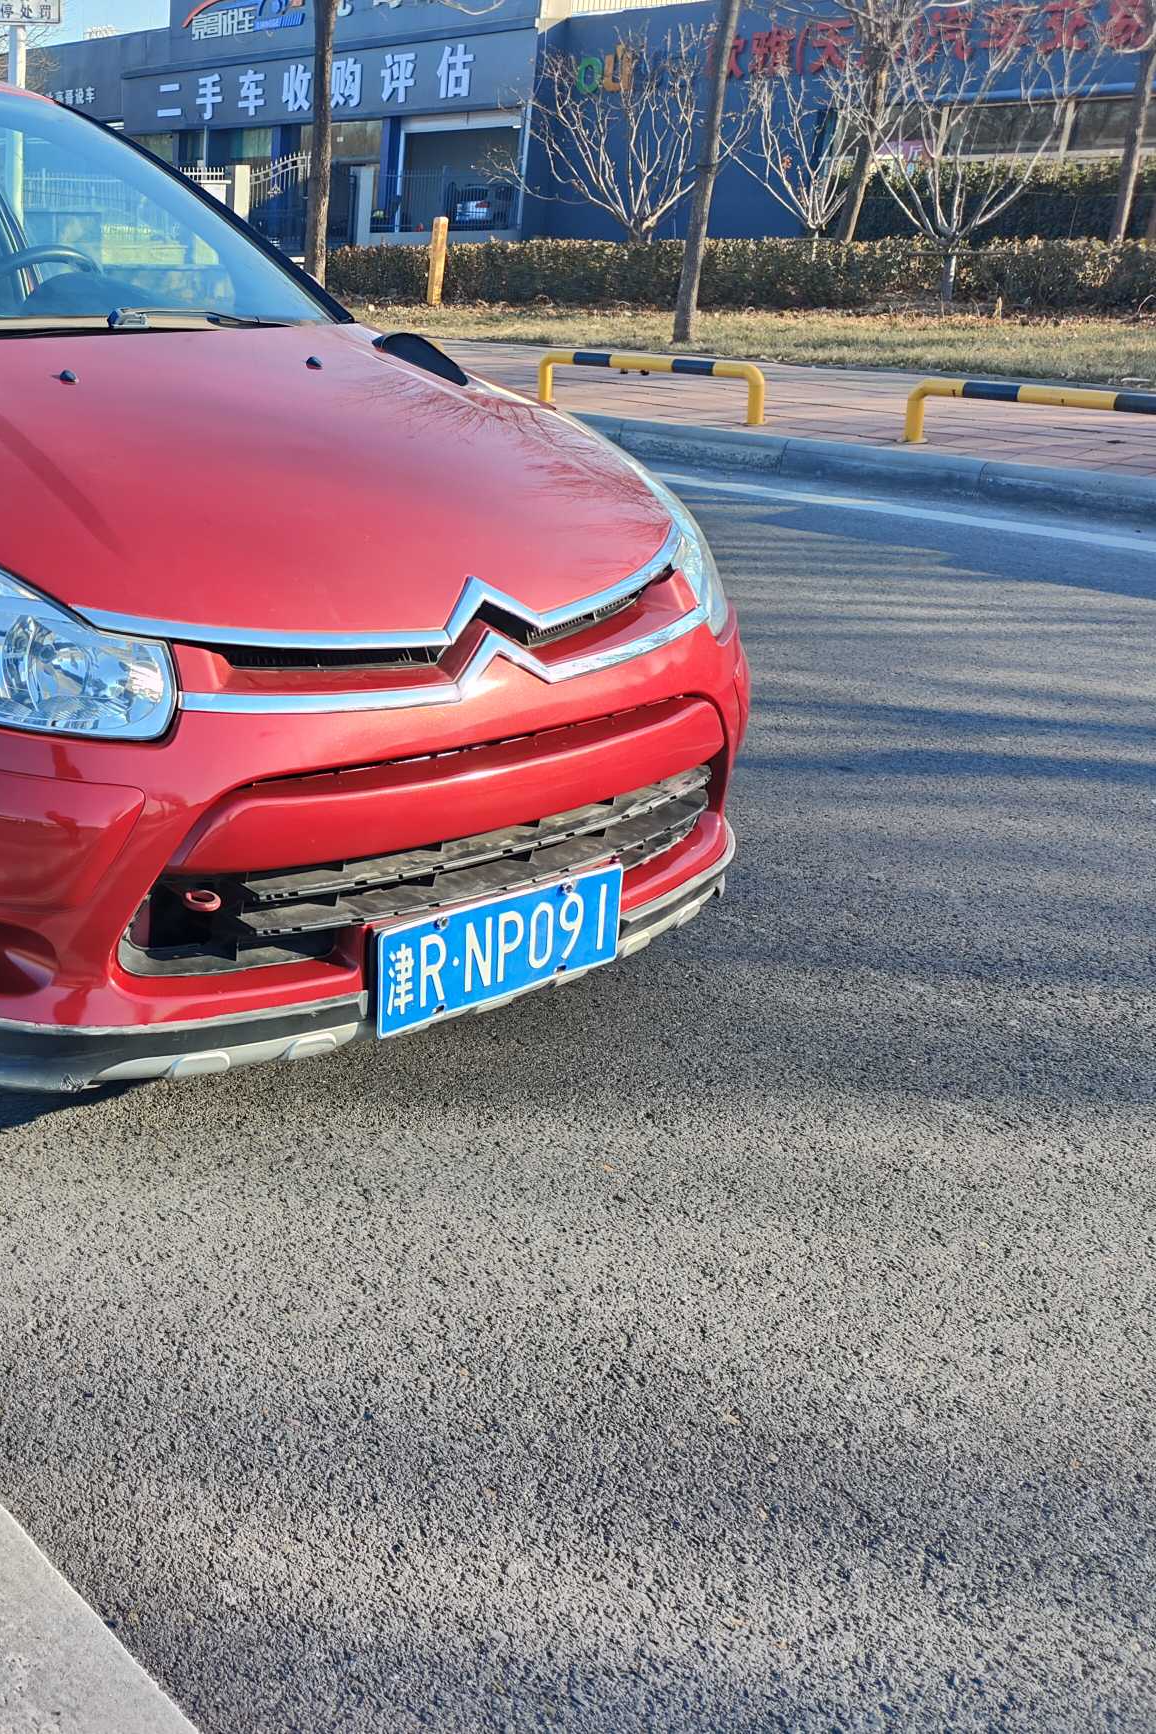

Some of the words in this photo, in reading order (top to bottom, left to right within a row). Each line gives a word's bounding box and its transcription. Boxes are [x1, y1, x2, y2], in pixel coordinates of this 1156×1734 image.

[156, 45, 475, 119] 二手车收购评估
[386, 883, 607, 1016] 津R·NP091
